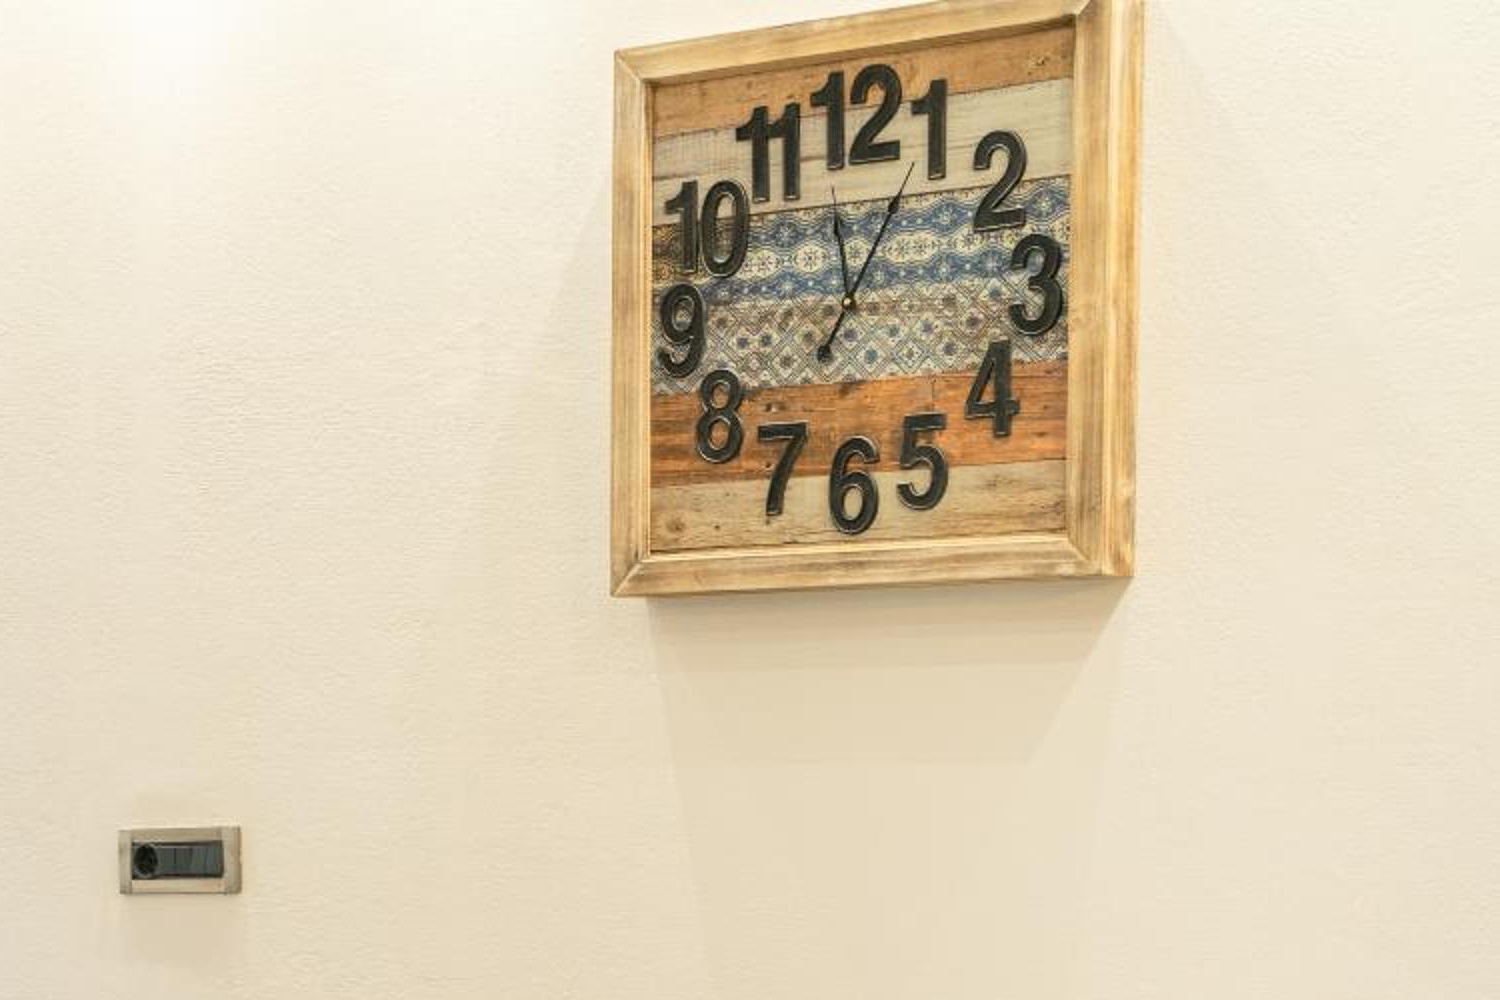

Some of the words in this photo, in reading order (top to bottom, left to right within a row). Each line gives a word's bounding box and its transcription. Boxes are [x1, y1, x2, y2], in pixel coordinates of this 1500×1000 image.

[736, 102, 801, 202] 11
[811, 63, 902, 170] 12
[911, 78, 947, 180] 1
[666, 179, 749, 277] 10
[973, 130, 1026, 231] 2
[656, 284, 708, 377] 9
[1009, 234, 1063, 335] 3
[696, 369, 743, 463] 8
[965, 340, 1020, 437] 4
[758, 422, 807, 516] 7
[829, 436, 879, 535] 6
[897, 413, 949, 510] 5
